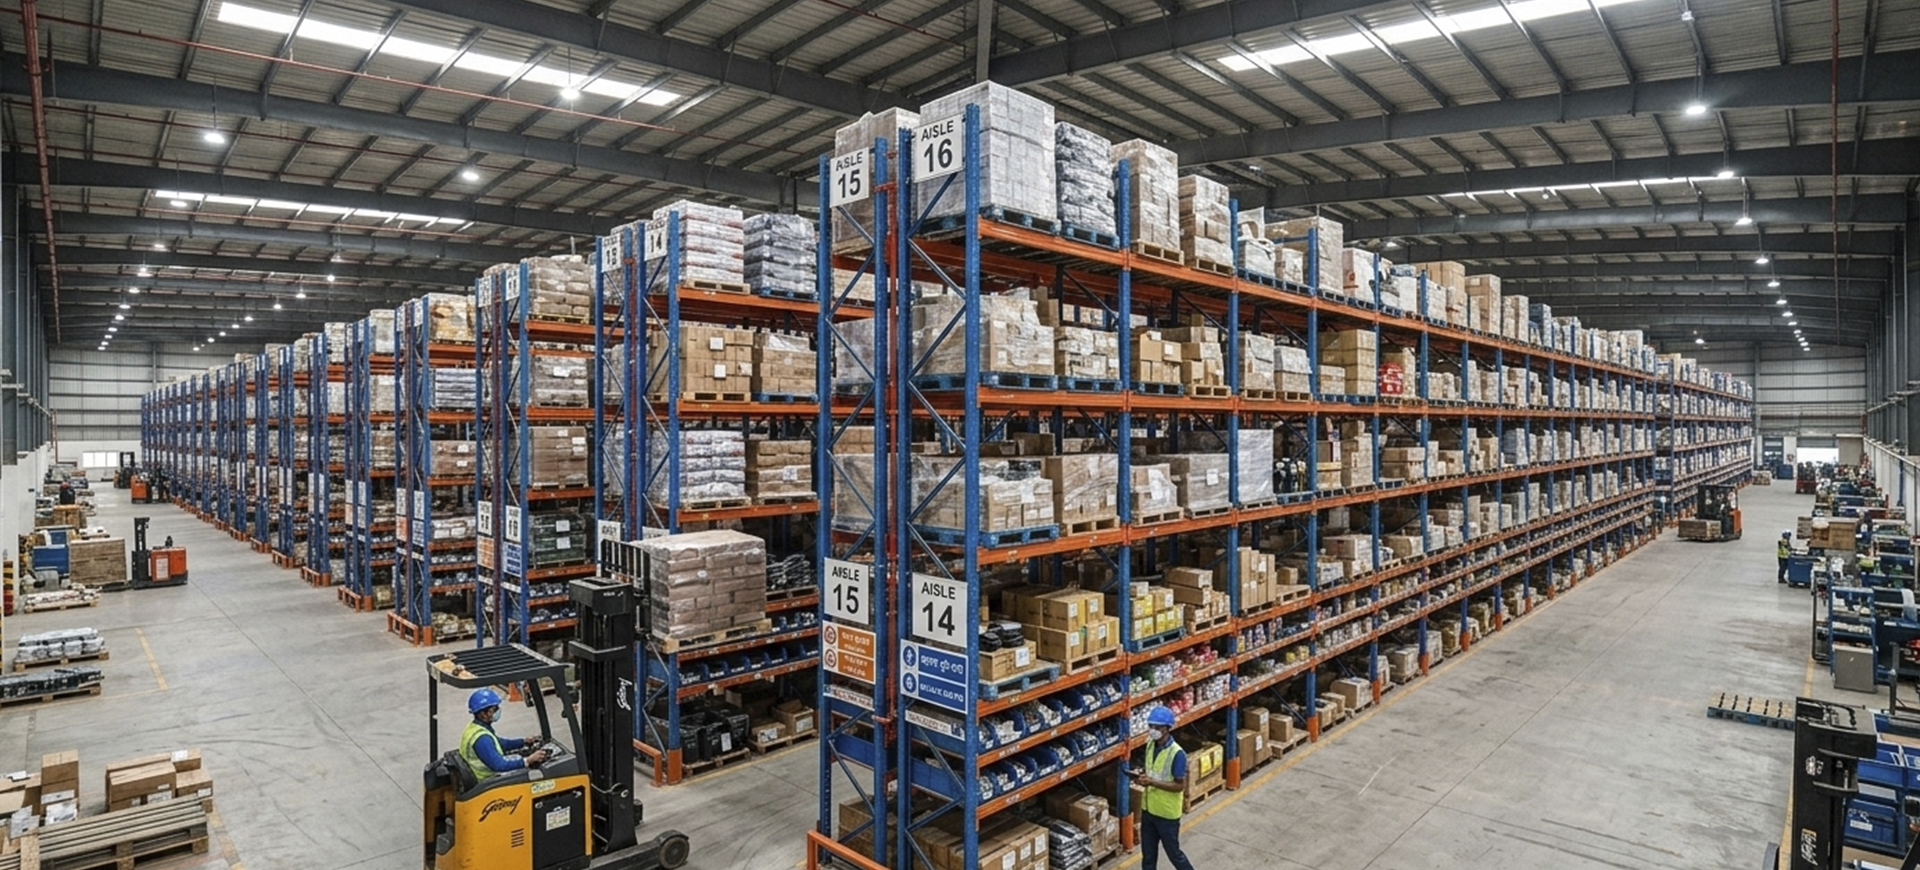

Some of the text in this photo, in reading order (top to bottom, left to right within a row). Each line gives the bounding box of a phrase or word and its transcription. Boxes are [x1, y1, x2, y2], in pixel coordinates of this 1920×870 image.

[921, 120, 954, 142] AISLE
[923, 138, 953, 173] 16
[837, 168, 861, 199] 15
[833, 583, 859, 615] 15
[921, 581, 956, 600] AISLE
[922, 601, 956, 637] 14
